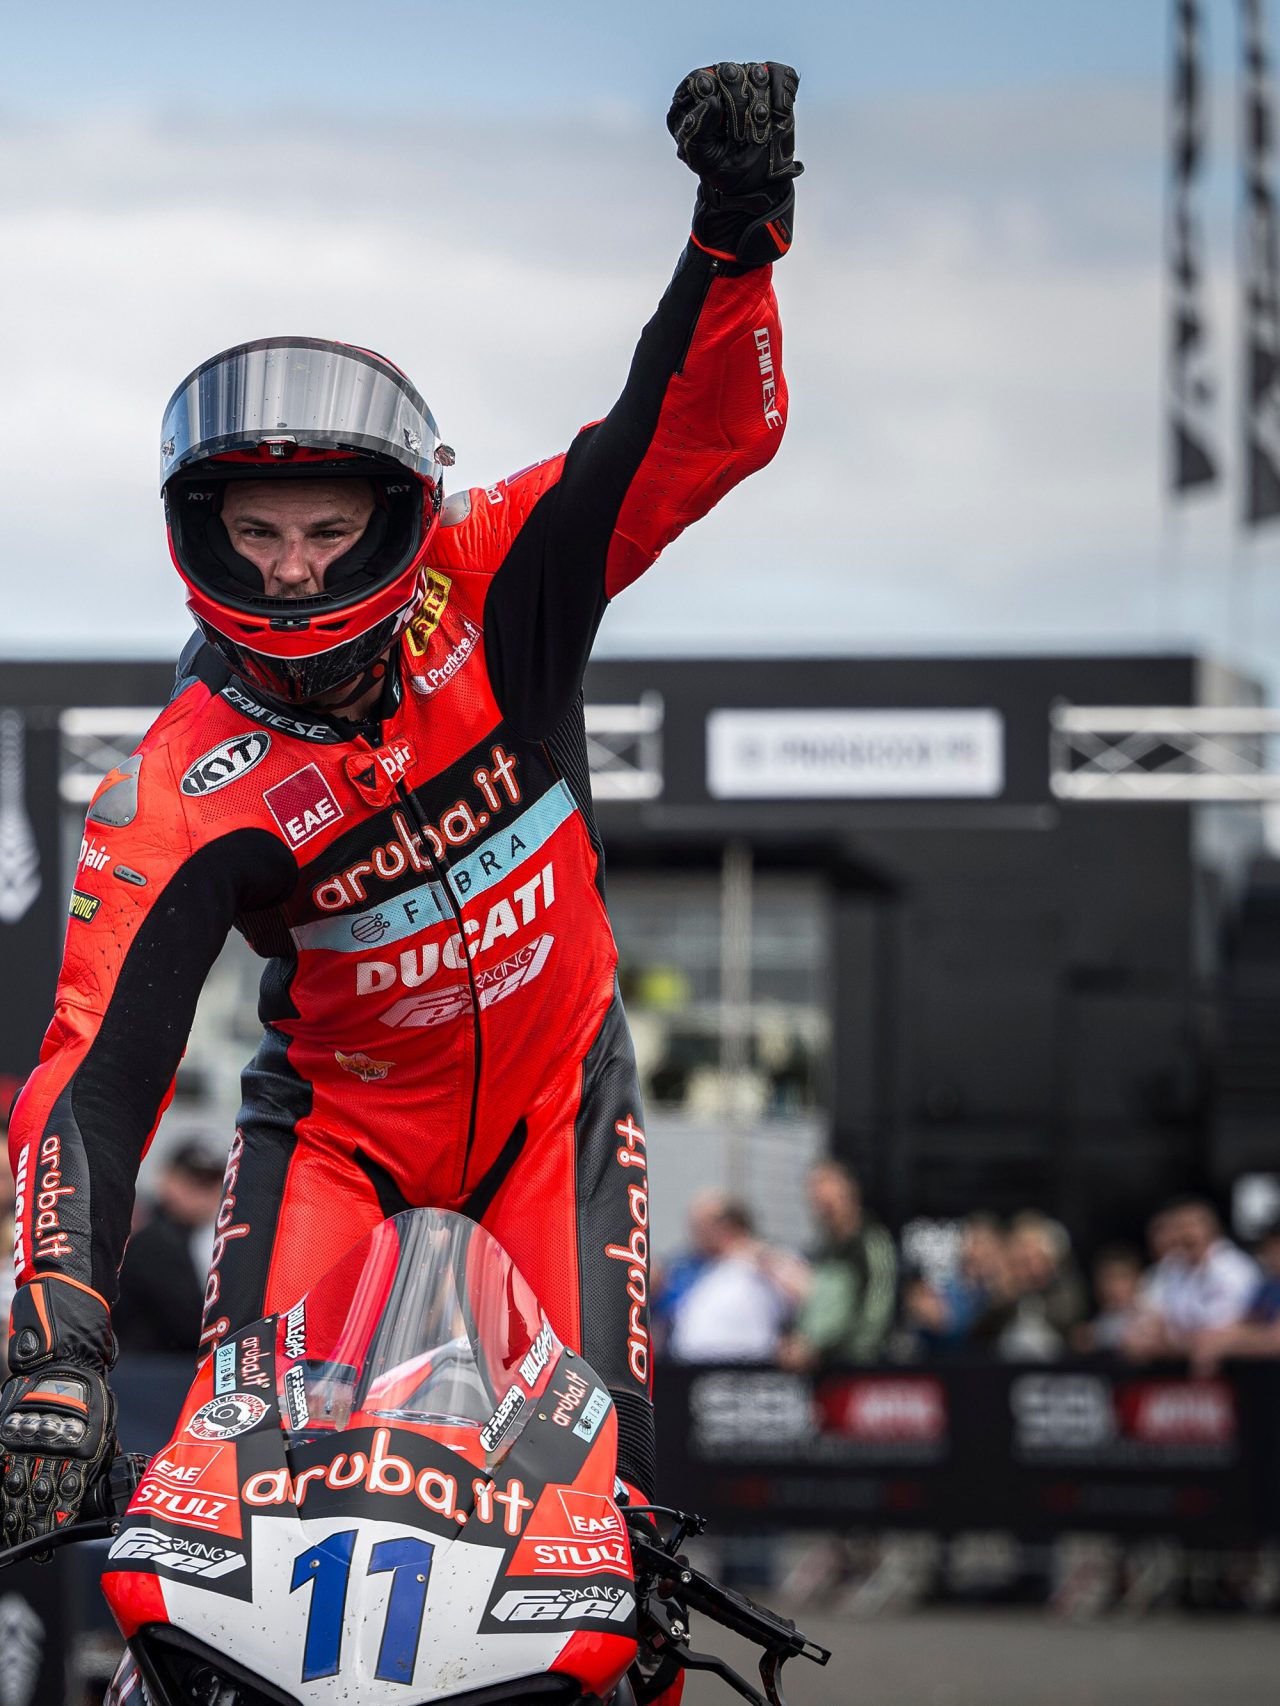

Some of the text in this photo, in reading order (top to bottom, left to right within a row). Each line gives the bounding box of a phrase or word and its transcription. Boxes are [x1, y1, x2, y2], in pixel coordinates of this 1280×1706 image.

[754, 327, 784, 429] DAINESE
[426, 620, 478, 687] Pratiche.it
[221, 687, 330, 739] DAINESE
[188, 732, 254, 793] KYT
[285, 797, 336, 842] EAE
[314, 747, 520, 911] aruba.it
[402, 833, 528, 925] FIBRA
[356, 861, 555, 996] DUCATI
[475, 949, 534, 988] RACING
[35, 1134, 76, 1259] aruba.it
[605, 1113, 649, 1385] aruba.it
[285, 1302, 307, 1359] BULEGAS
[518, 1323, 553, 1387] BULEGAS
[220, 1357, 234, 1388] FIBA
[241, 1336, 271, 1387] aruba.it
[490, 1397, 524, 1447] ACCESSORI
[552, 1369, 590, 1427] aruba.it
[587, 1394, 607, 1424] FIBRA
[216, 1426, 241, 1437] GAS
[154, 1459, 202, 1481] EAE
[242, 1427, 534, 1536] aruba.it
[137, 1484, 227, 1520] STULZ
[572, 1515, 620, 1533] EAE
[173, 1538, 226, 1561] RACING
[534, 1543, 628, 1565] STULZ
[289, 1528, 436, 1686] 11
[561, 1585, 620, 1602] RACING
